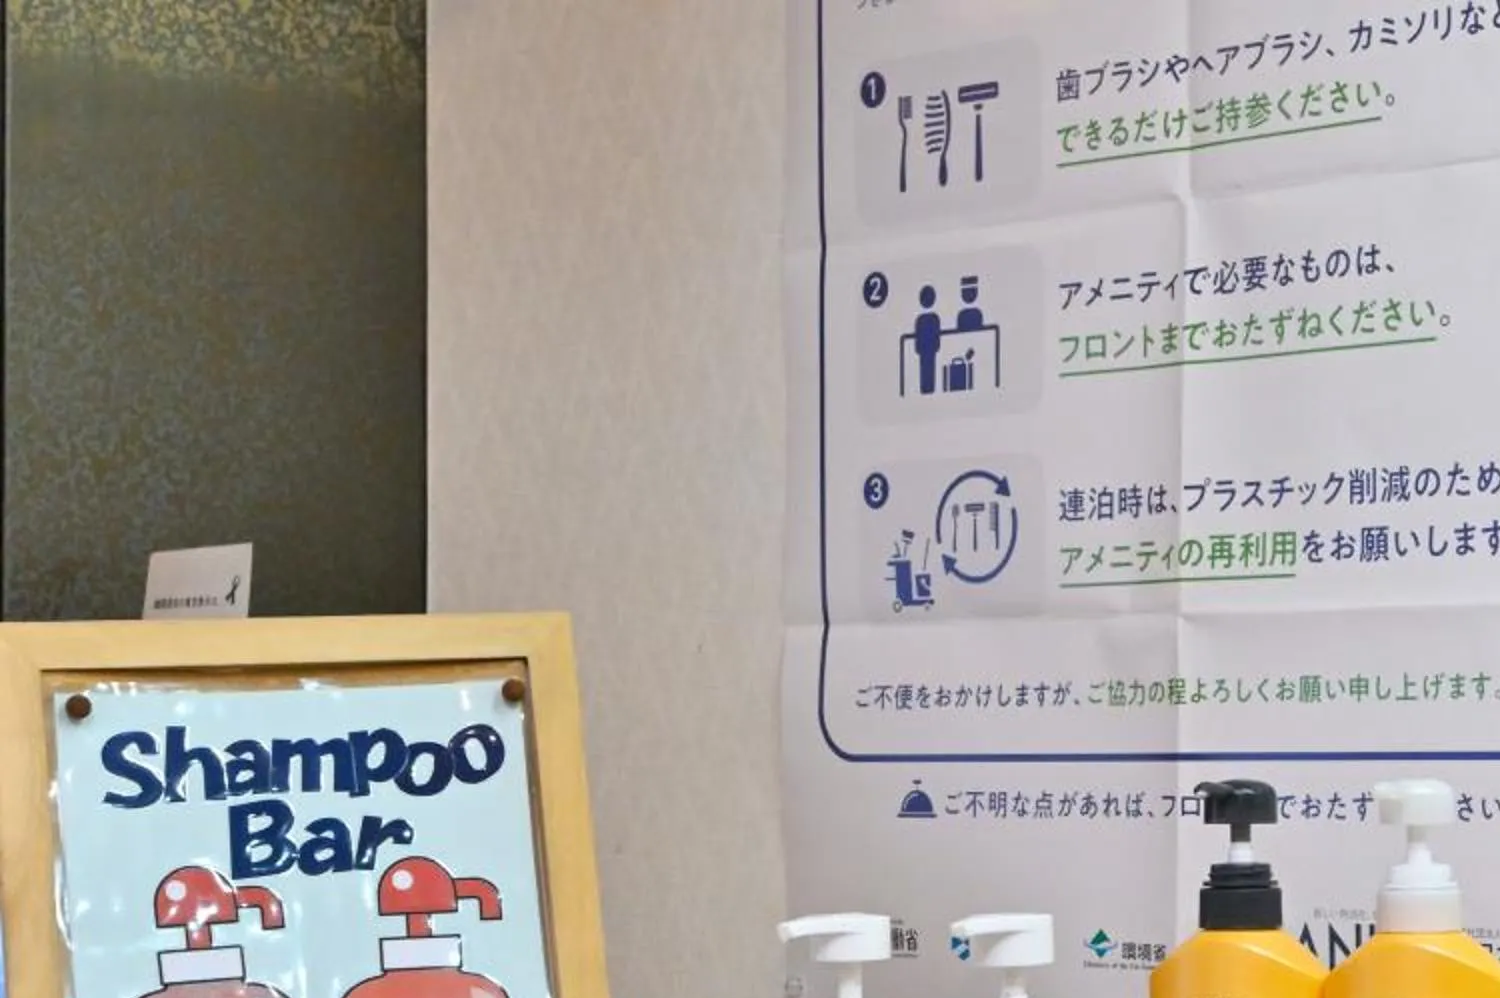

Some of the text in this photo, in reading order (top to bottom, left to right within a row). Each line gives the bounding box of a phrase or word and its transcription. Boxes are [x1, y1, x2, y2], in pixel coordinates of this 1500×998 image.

[1056, 79, 1395, 154] できるだけご持参ください。
[1059, 243, 1394, 311] アメニティで必要なものは、
[1059, 295, 1450, 364] フロントまでおたずねください。
[102, 722, 506, 809] Shampoo
[228, 799, 413, 880] Bar
